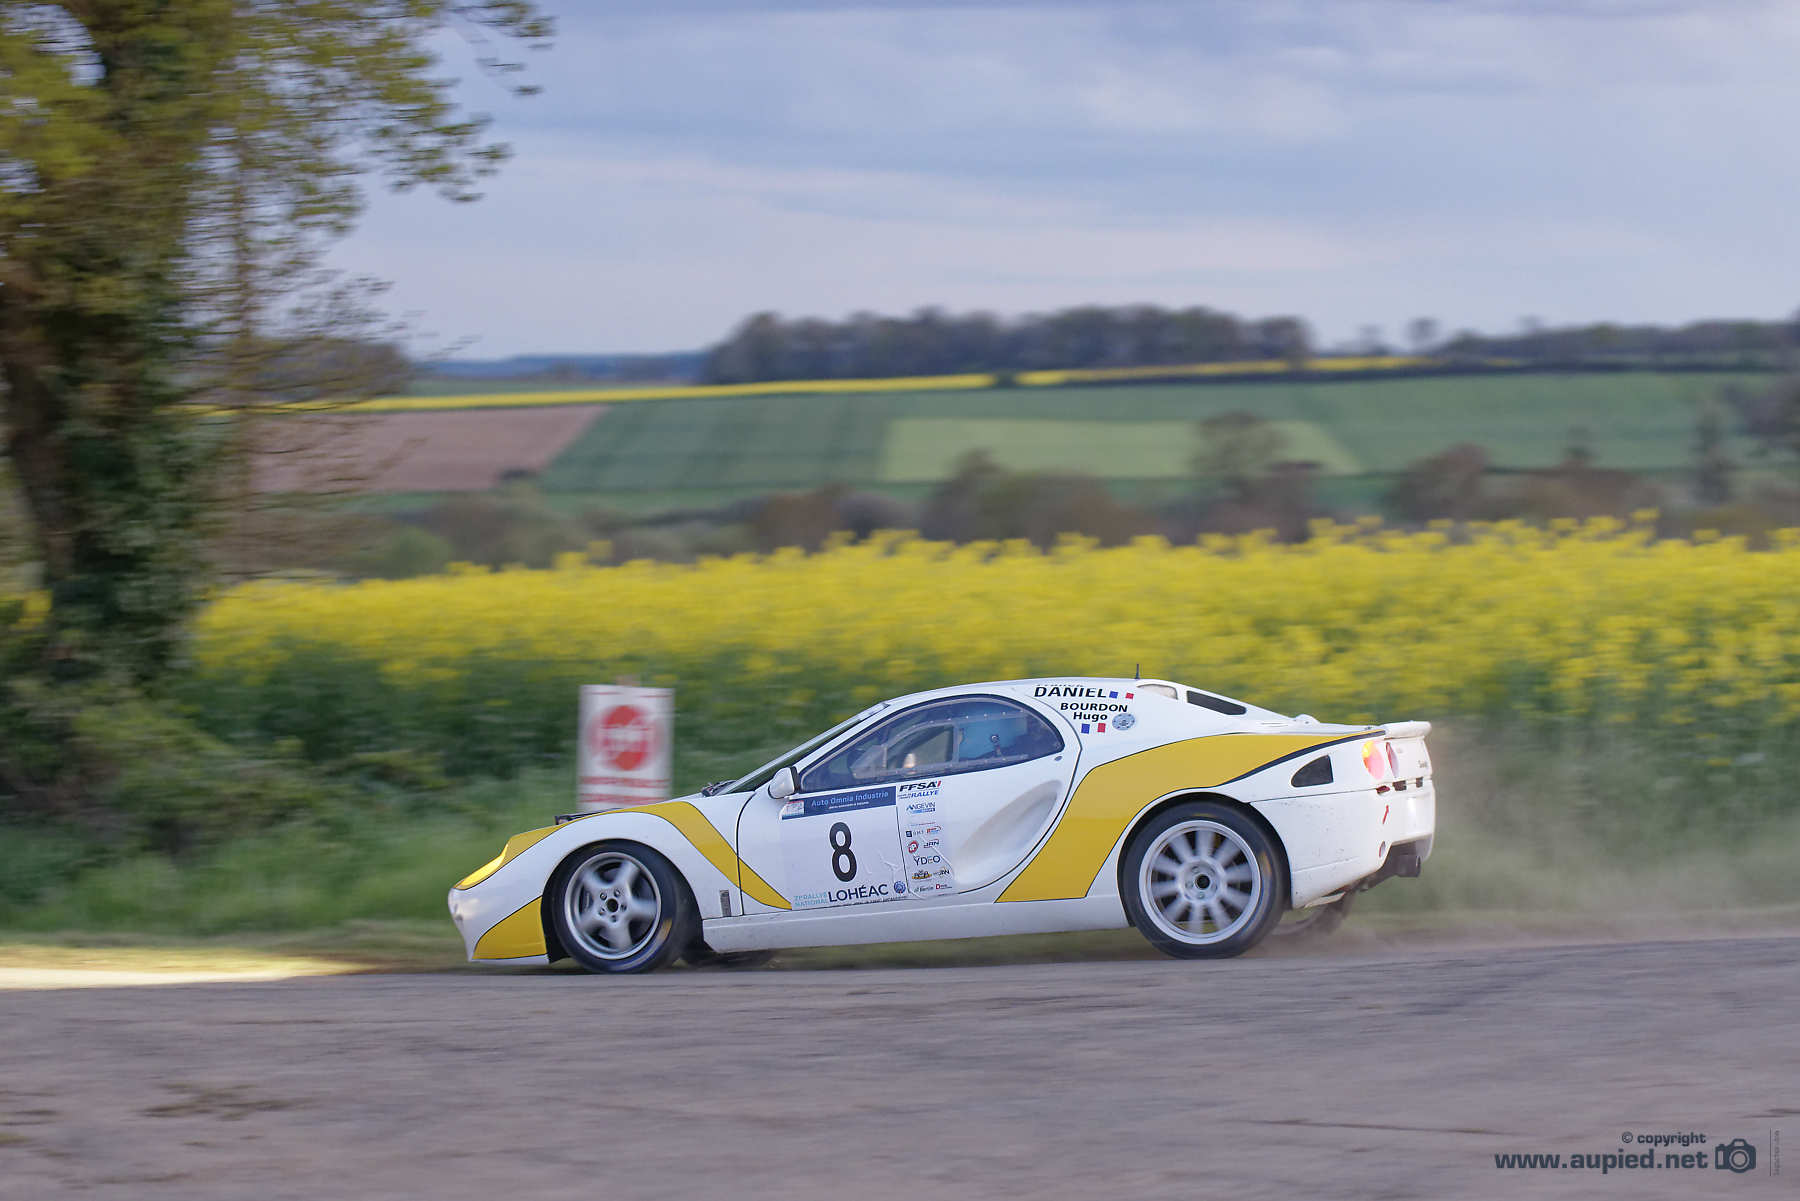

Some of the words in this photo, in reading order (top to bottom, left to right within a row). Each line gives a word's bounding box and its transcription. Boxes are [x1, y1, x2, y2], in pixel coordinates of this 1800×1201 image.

[1034, 686, 1107, 698] DANIEL
[1060, 702, 1128, 713] BOURDON
[1073, 711, 1108, 723] Hugo
[899, 781, 938, 792] FFSA
[811, 799, 829, 807] Auto
[830, 796, 854, 805] Omnia
[829, 821, 858, 883] 8
[828, 883, 889, 903] LOHÉAC
